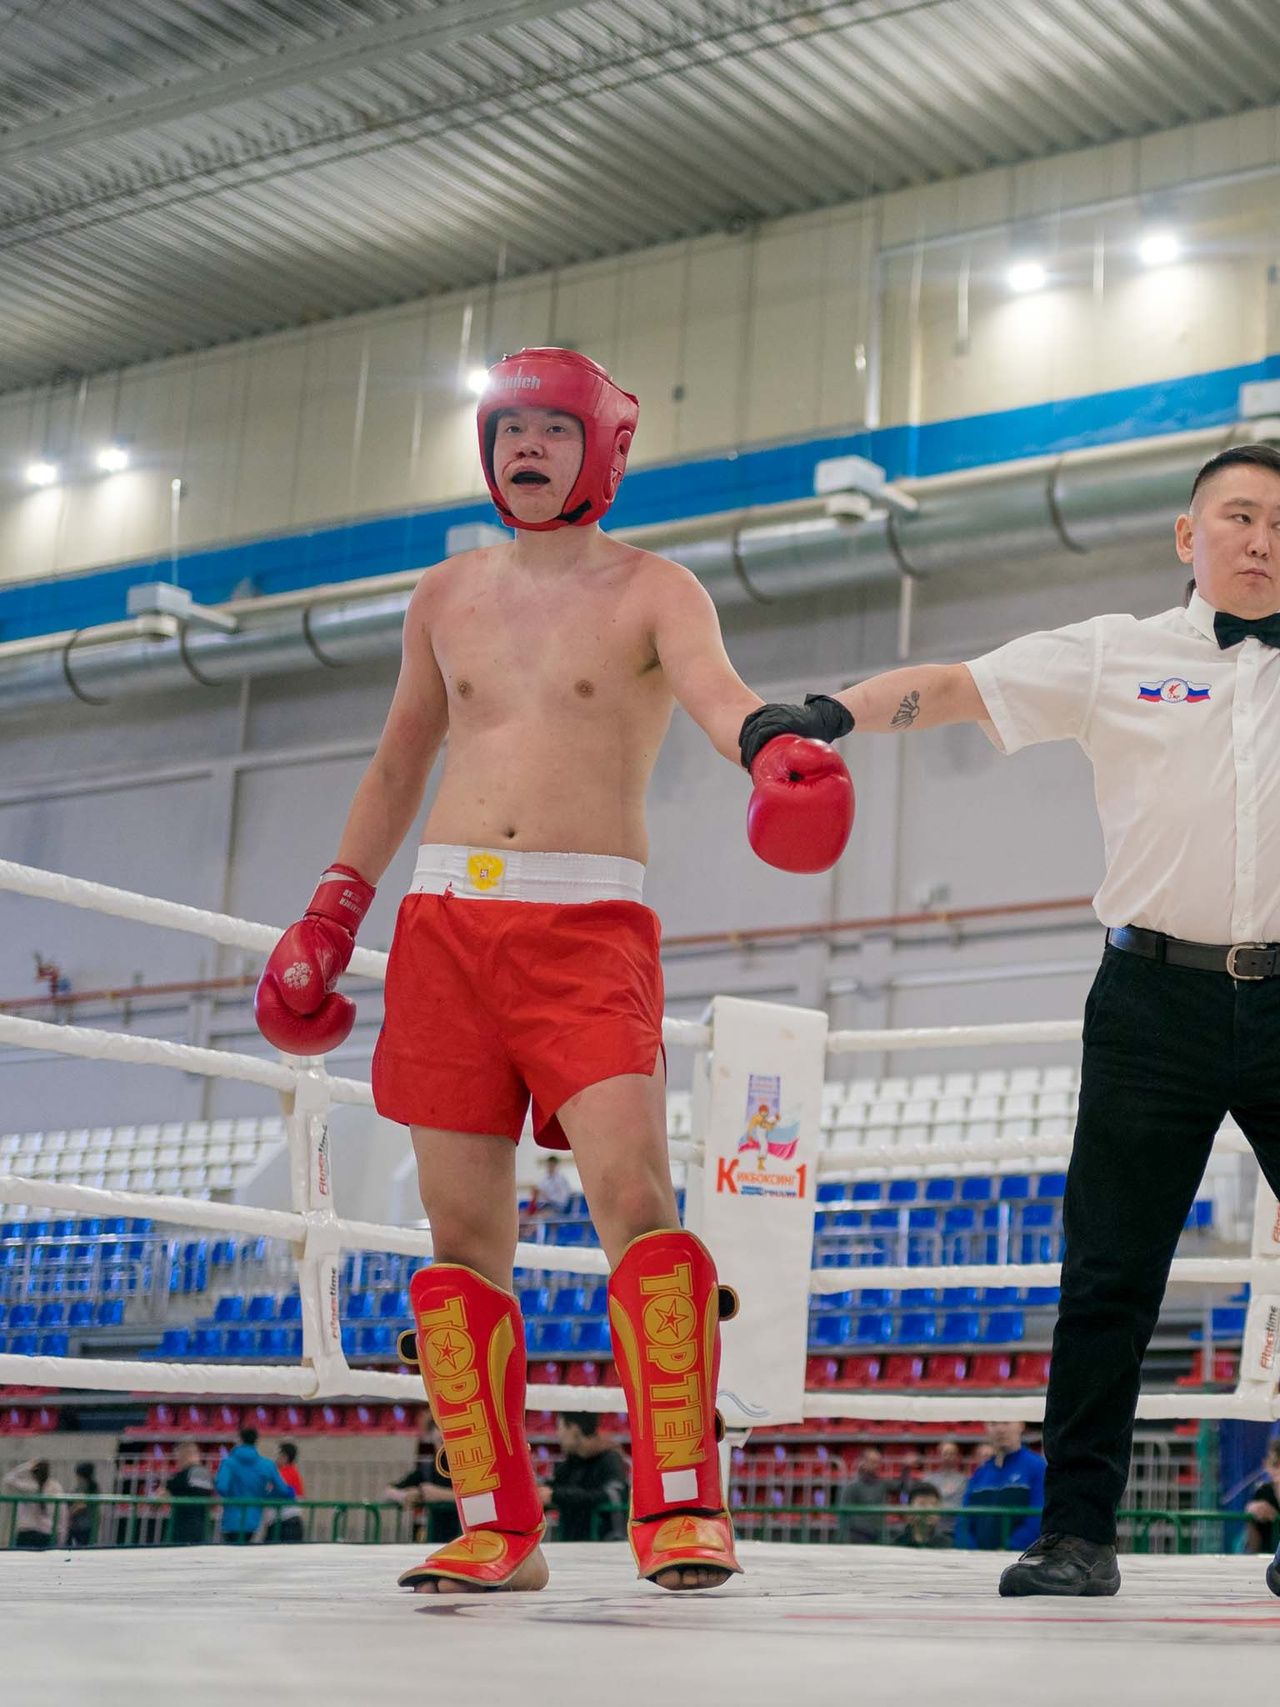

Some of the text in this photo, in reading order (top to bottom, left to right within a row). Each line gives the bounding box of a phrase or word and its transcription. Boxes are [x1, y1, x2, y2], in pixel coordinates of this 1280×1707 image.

[419, 1296, 501, 1498] TOP TEN
[640, 1263, 707, 1470] TOP TEN
